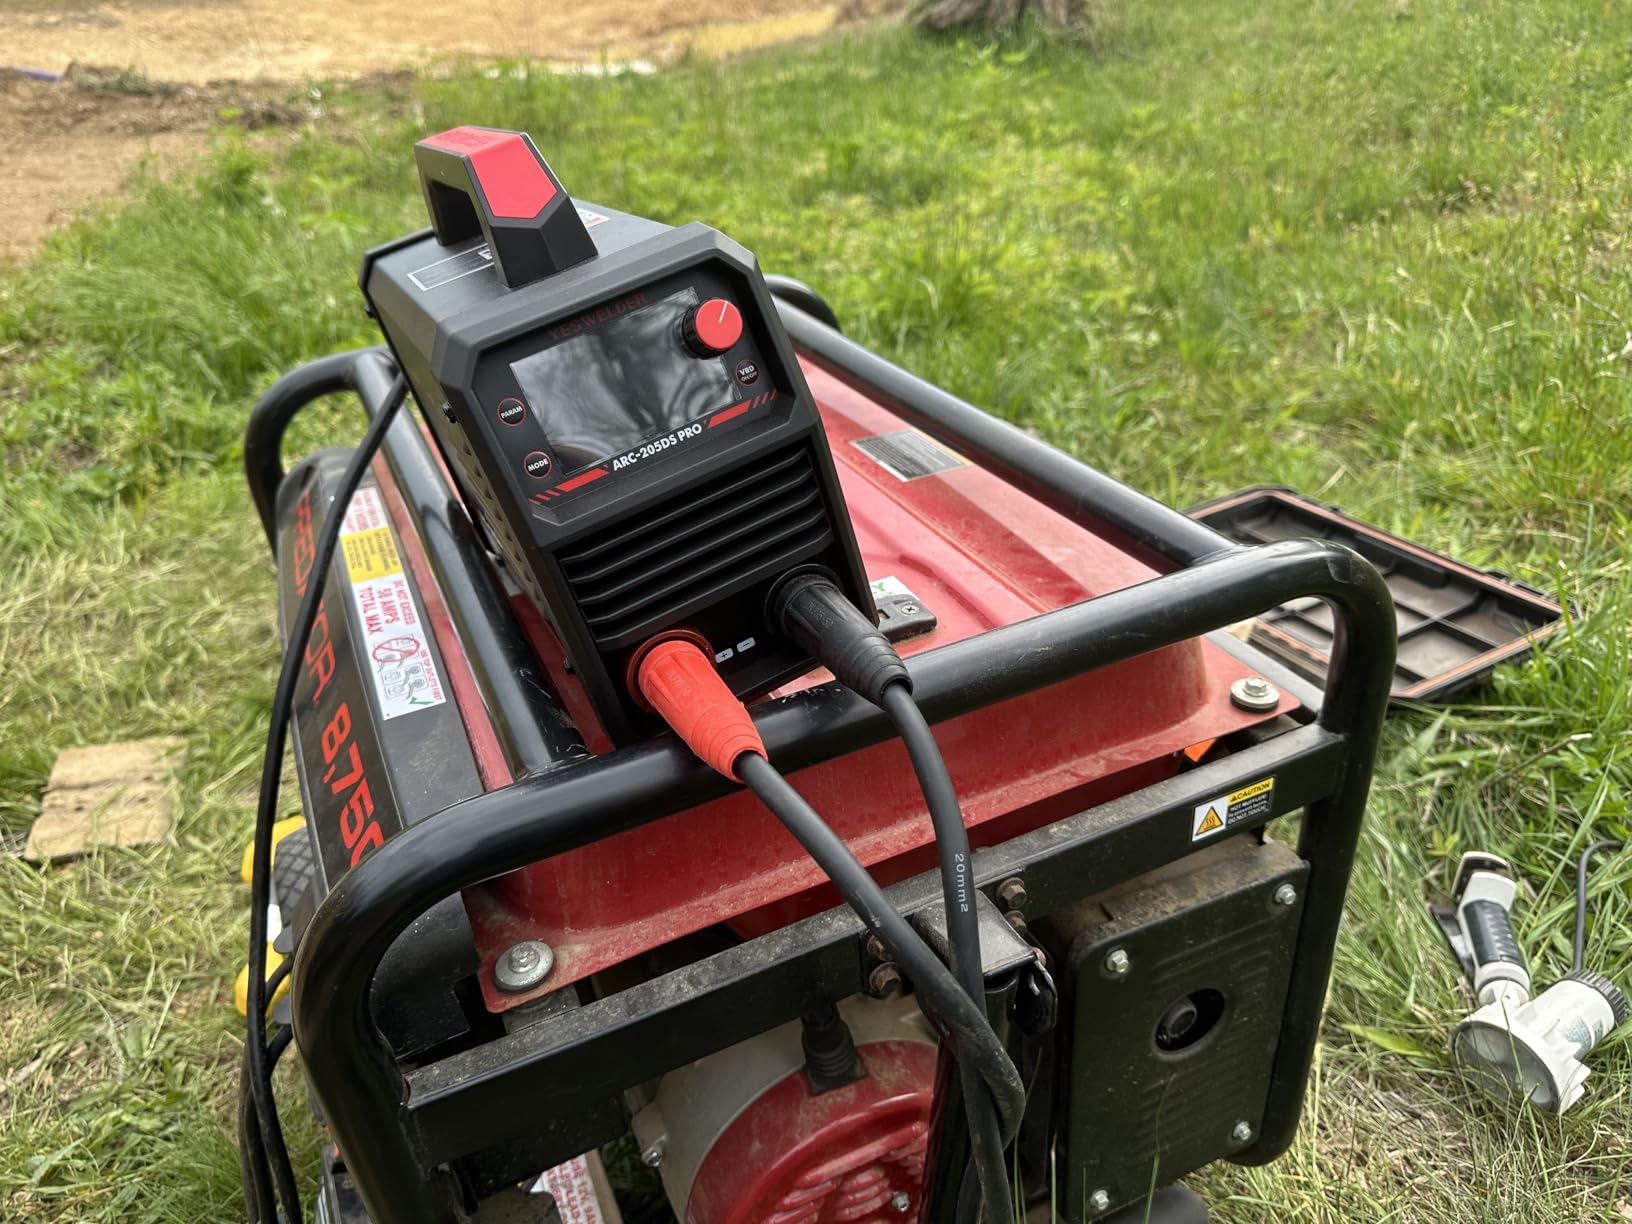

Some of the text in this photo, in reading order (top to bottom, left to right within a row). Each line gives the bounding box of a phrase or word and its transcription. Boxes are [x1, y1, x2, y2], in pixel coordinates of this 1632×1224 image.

[739, 365, 755, 376] VRD
[501, 405, 522, 418] PARAM
[612, 423, 702, 471] ARC-205DS PRO
[528, 458, 548, 472] MODE
[359, 586, 384, 636] TOTAL MAX
[381, 600, 400, 625] AMPS
[1236, 782, 1271, 801] CAUTION
[954, 853, 969, 913] 20mm2
